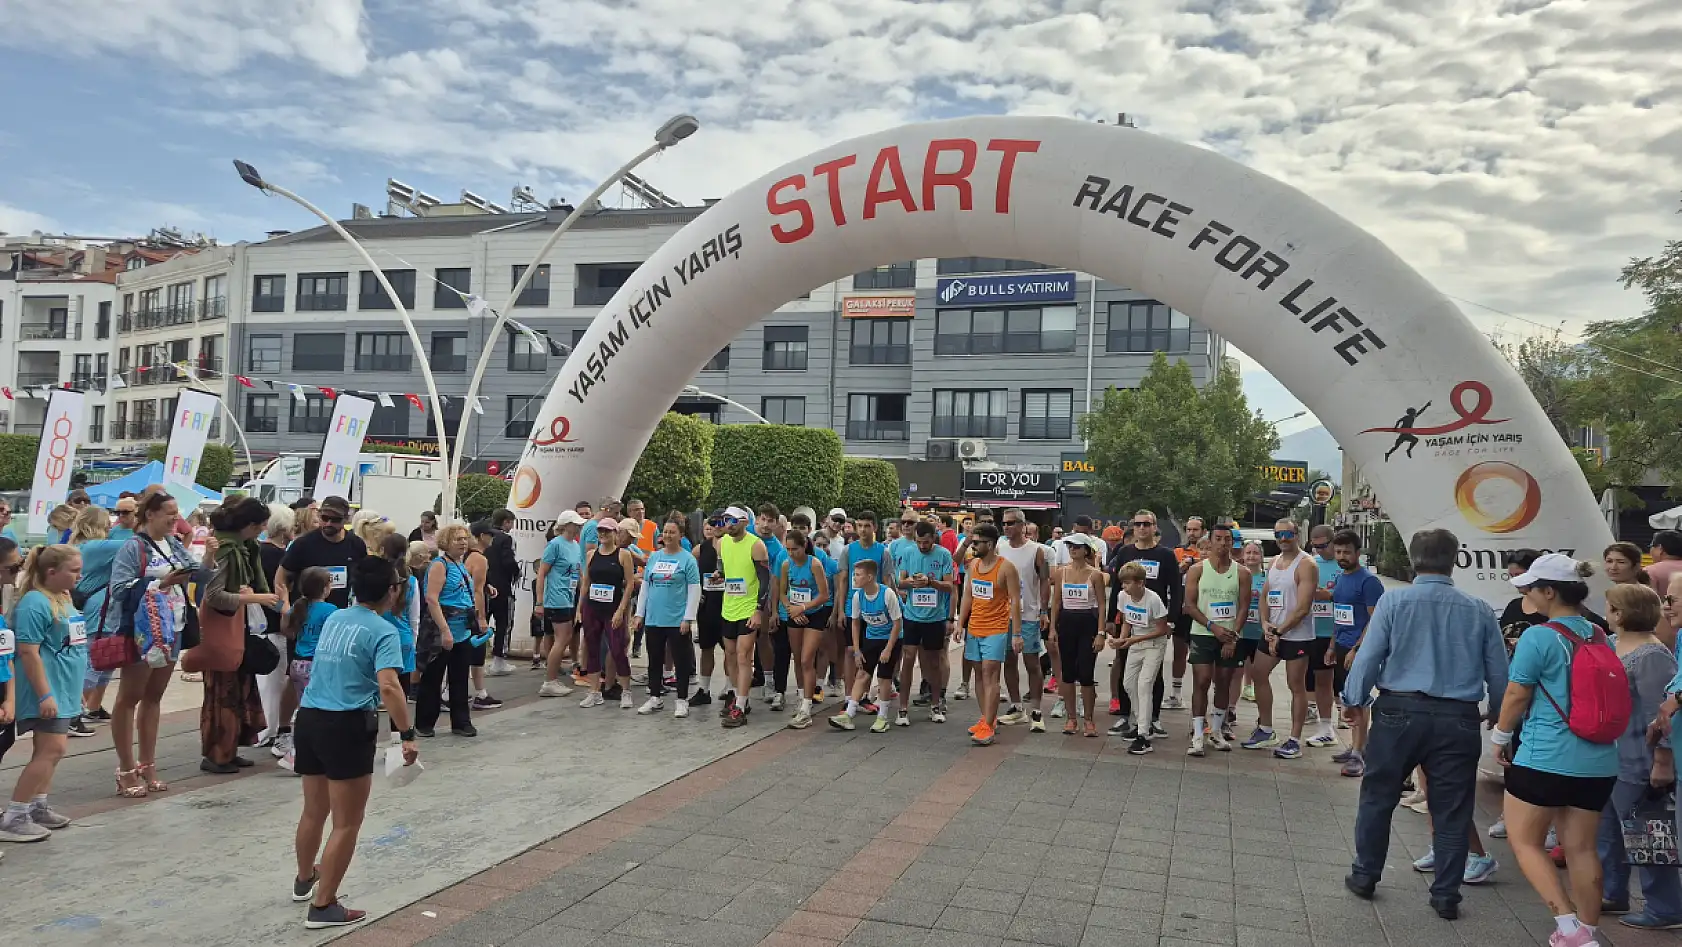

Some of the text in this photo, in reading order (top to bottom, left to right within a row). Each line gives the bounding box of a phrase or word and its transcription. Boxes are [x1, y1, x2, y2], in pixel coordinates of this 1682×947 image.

[766, 138, 1041, 243] START
[1073, 174, 1387, 367] RACE FOR LIFE
[968, 280, 1070, 296] BULLS YATIRIM
[887, 298, 914, 309] PERUK
[568, 319, 630, 404] YAŞAM
[674, 223, 743, 286] YARIŞ
[180, 409, 209, 432] FIAT
[336, 414, 365, 438] FIAT
[1424, 433, 1523, 448] YAŞAM İÇİN YARIŞ
[171, 456, 196, 477] FIAT
[322, 462, 350, 485] FIAT
[979, 472, 1040, 487] FOR YOU
[992, 486, 1026, 499] Boutique
[1215, 608, 1230, 616] 110
[1313, 604, 1327, 612] 034
